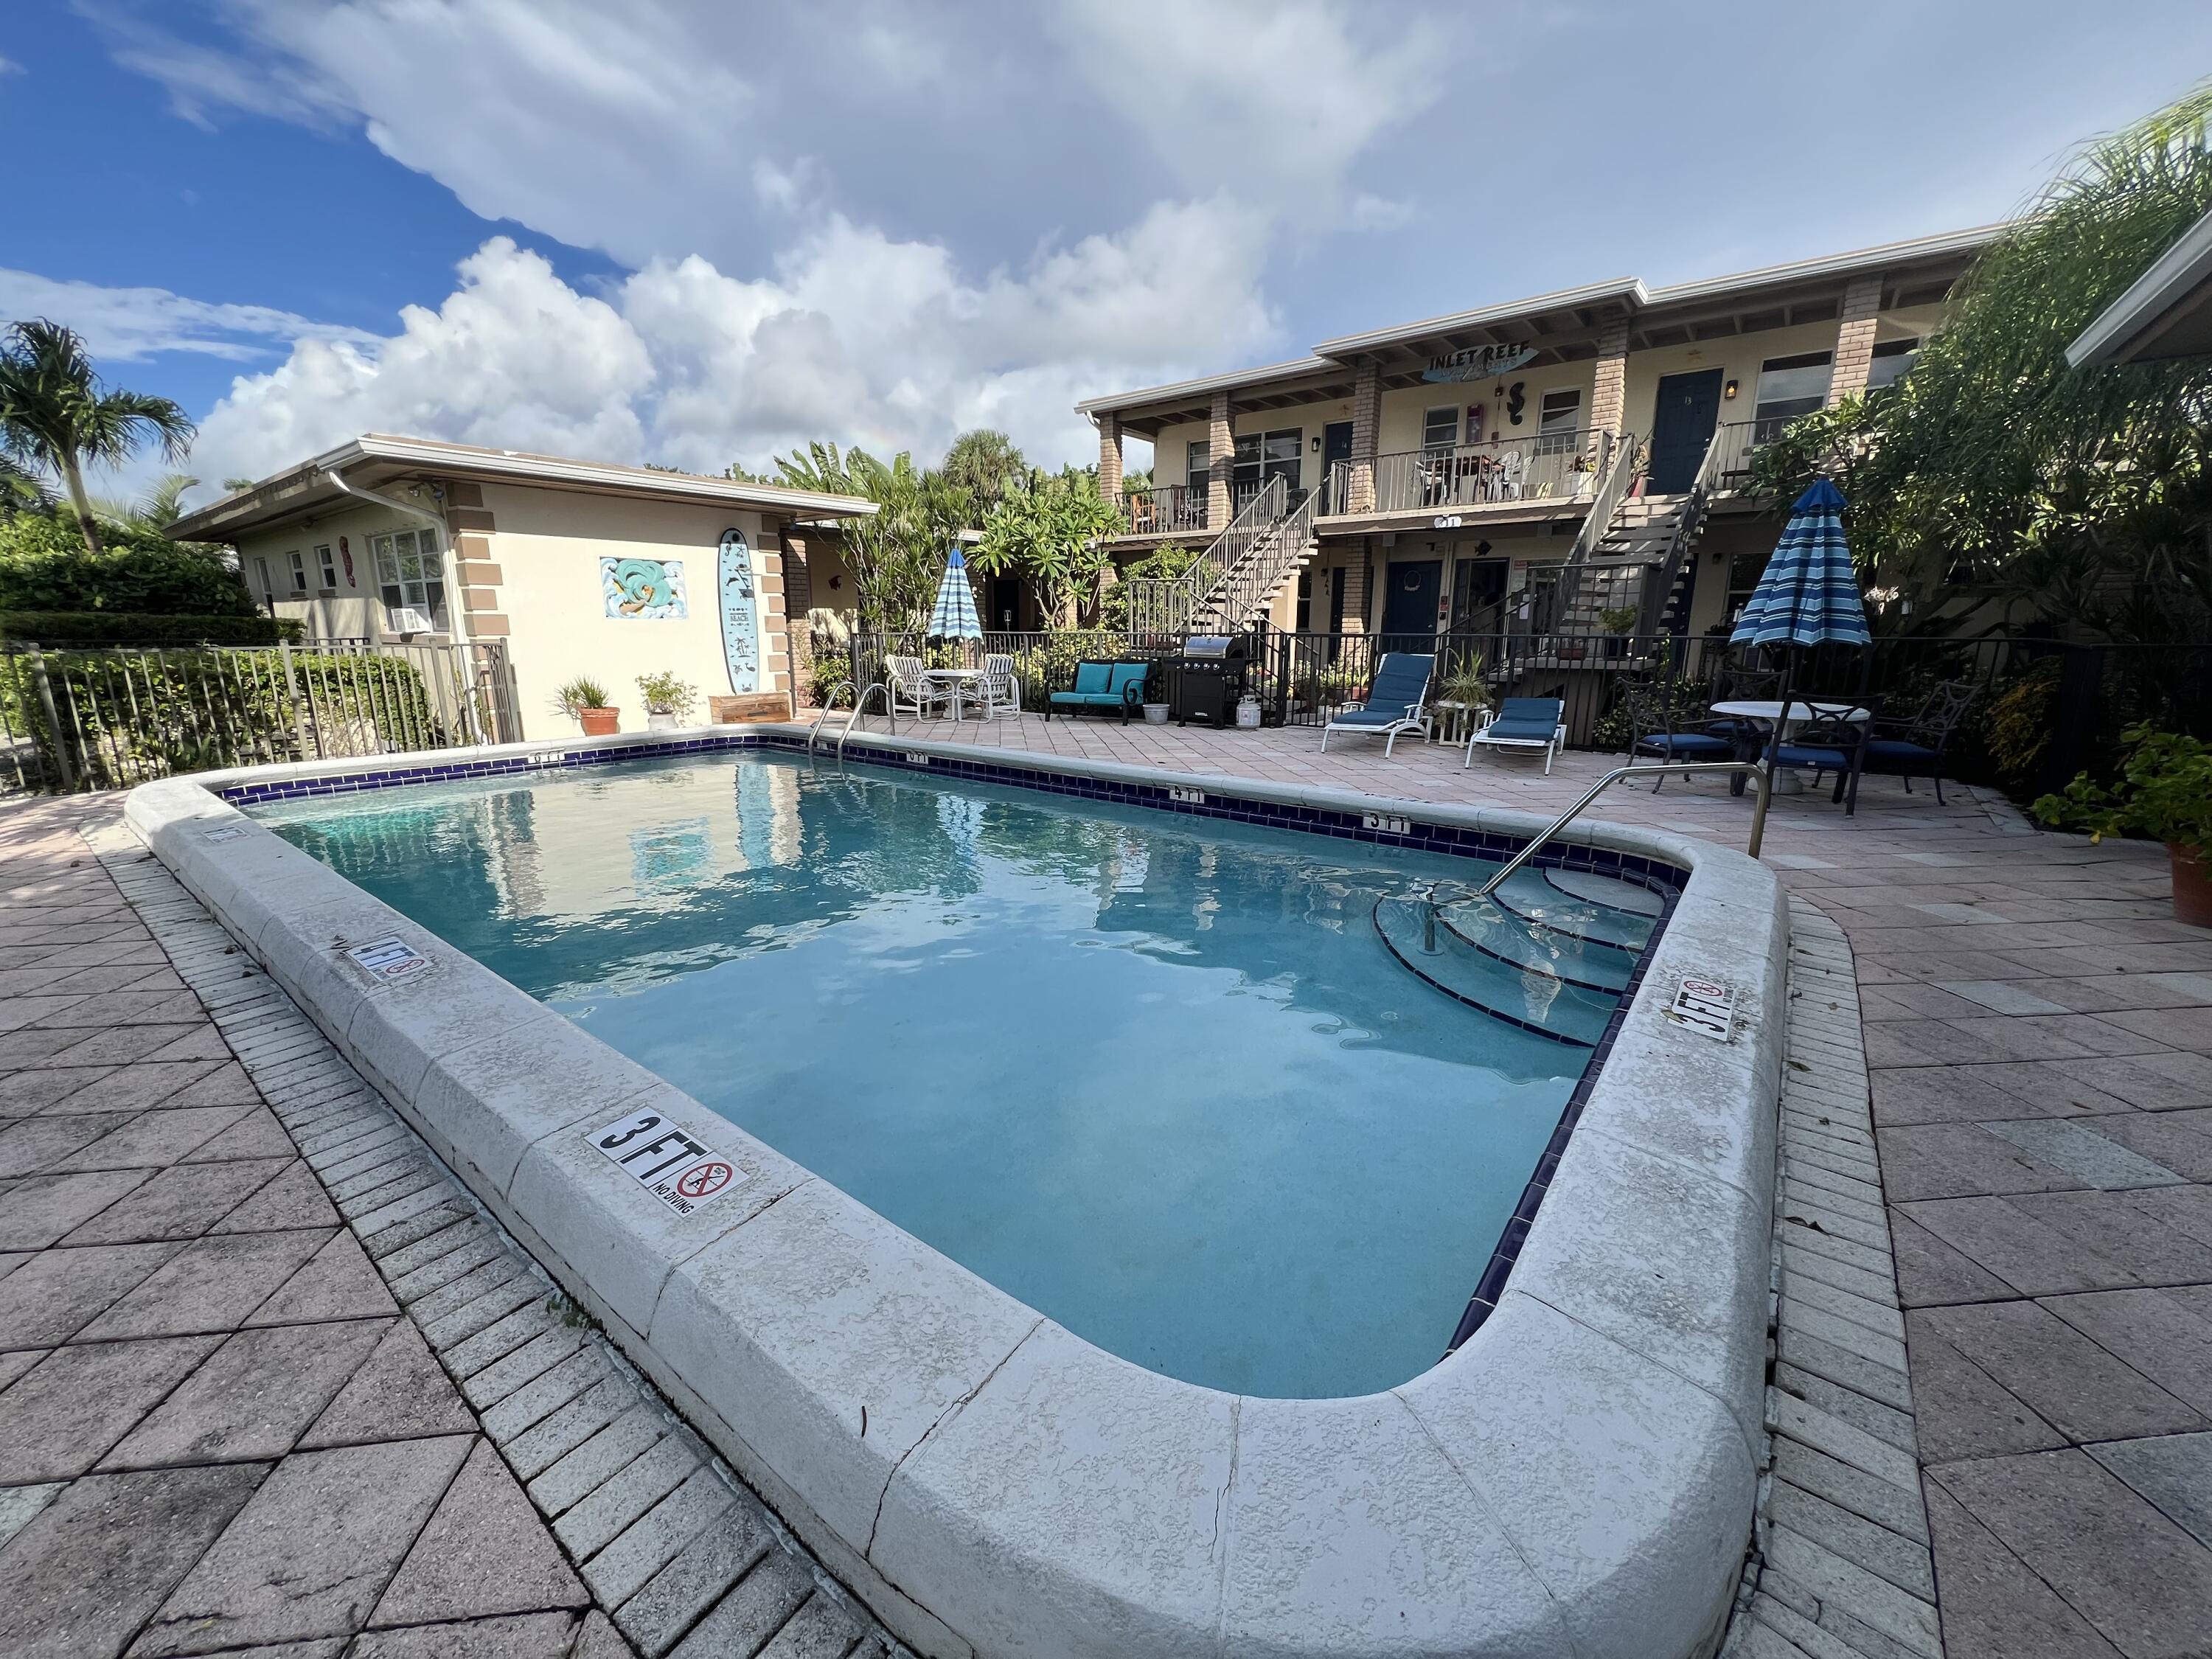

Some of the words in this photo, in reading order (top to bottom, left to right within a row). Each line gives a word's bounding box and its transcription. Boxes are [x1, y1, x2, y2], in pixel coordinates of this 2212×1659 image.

[1429, 349, 1478, 371] INLET
[1484, 340, 1530, 363] REEF
[1175, 785, 1182, 799] 4
[1186, 787, 1201, 802] FT
[1371, 813, 1380, 827] 3
[1387, 815, 1408, 832] FT
[353, 941, 399, 956] 4
[361, 947, 417, 967] FT
[1677, 992, 1731, 1021] FT
[1674, 1013, 1726, 1033] 3
[599, 1116, 661, 1149] 3
[619, 1130, 708, 1180] FT
[653, 1183, 667, 1195] NO
[663, 1192, 695, 1214] DIVING
